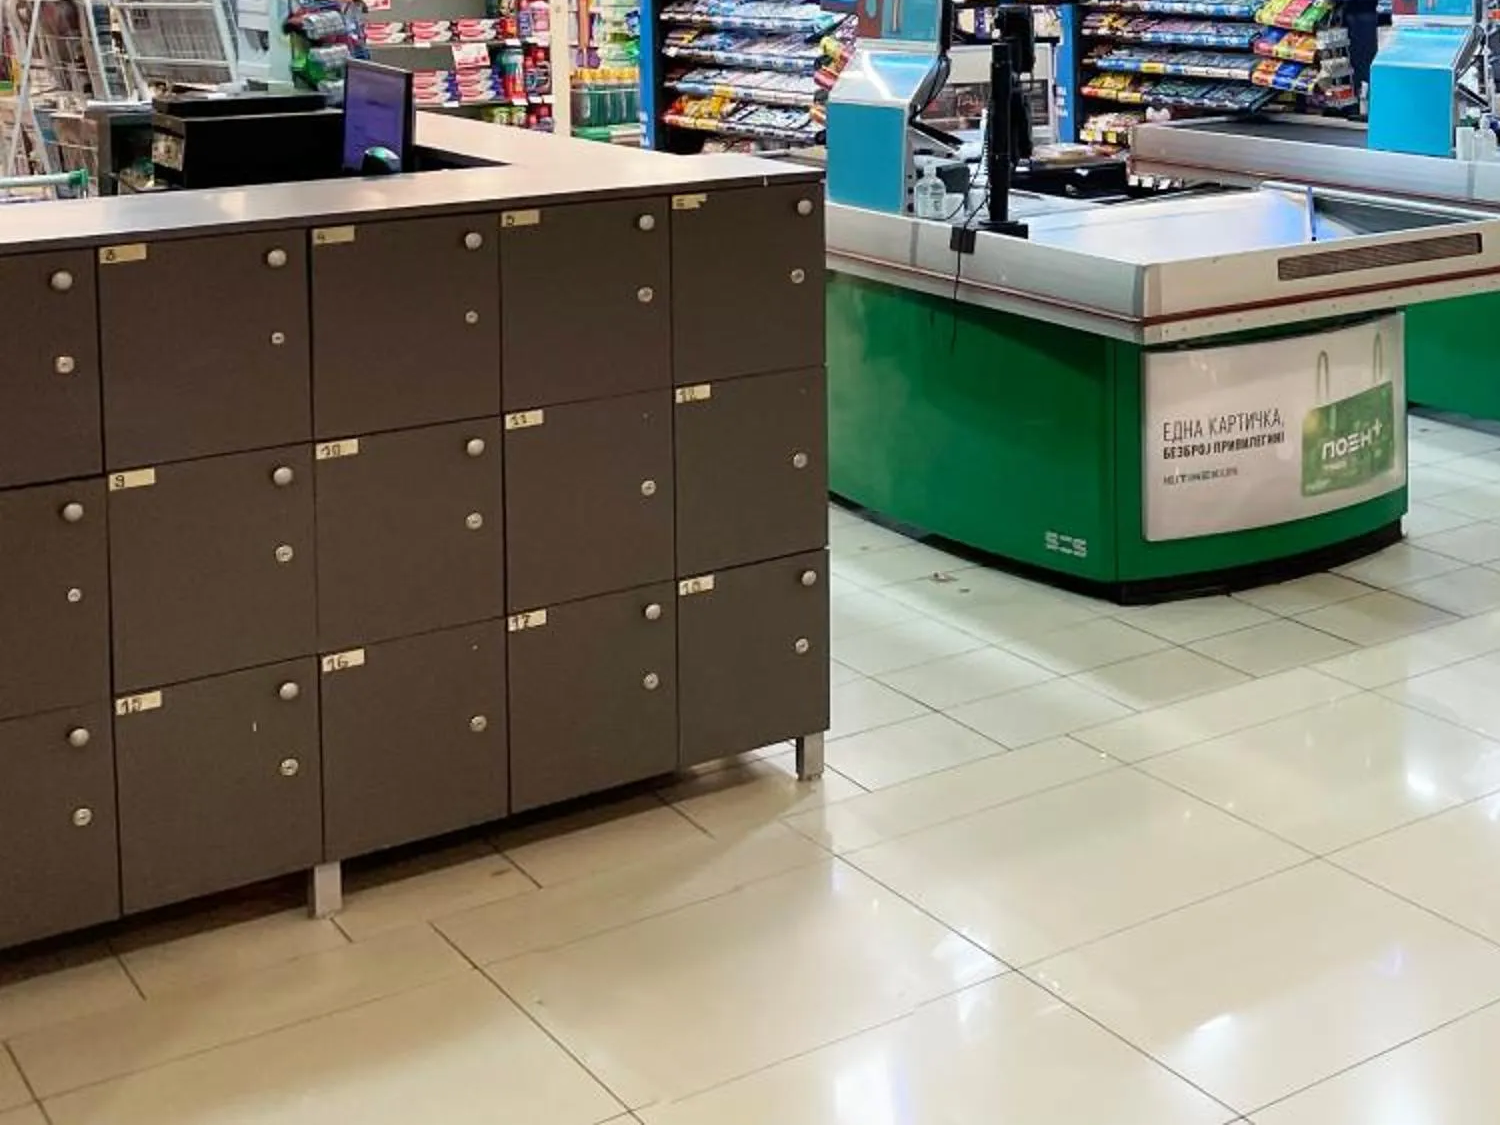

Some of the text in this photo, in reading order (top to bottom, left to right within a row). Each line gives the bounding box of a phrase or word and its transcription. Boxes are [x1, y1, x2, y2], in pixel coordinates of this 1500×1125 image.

[1163, 419, 1203, 444] ЕДНА
[1163, 442, 1211, 460] БЕЗБРОЈ
[115, 474, 125, 488] 9
